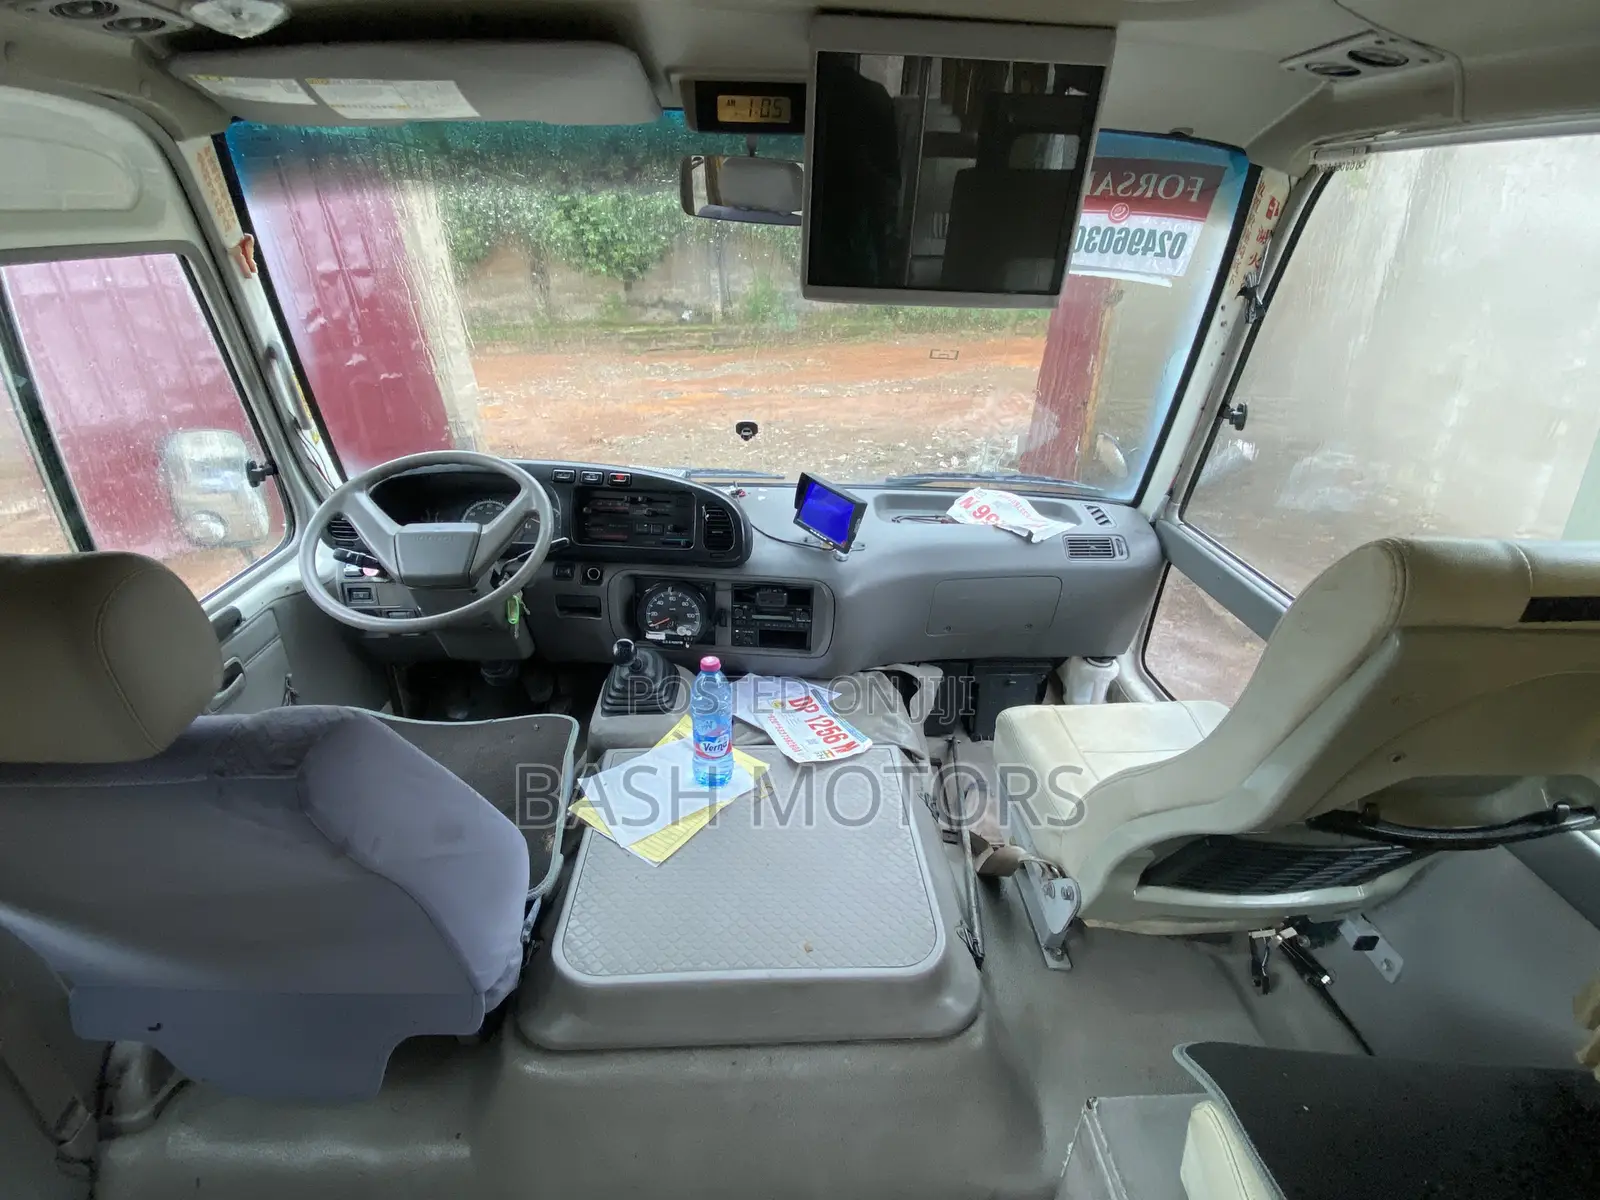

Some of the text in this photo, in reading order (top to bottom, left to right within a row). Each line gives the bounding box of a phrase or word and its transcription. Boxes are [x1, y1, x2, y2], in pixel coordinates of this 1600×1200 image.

[787, 695, 861, 754] DP 1256 N
[702, 740, 728, 752] Verna
